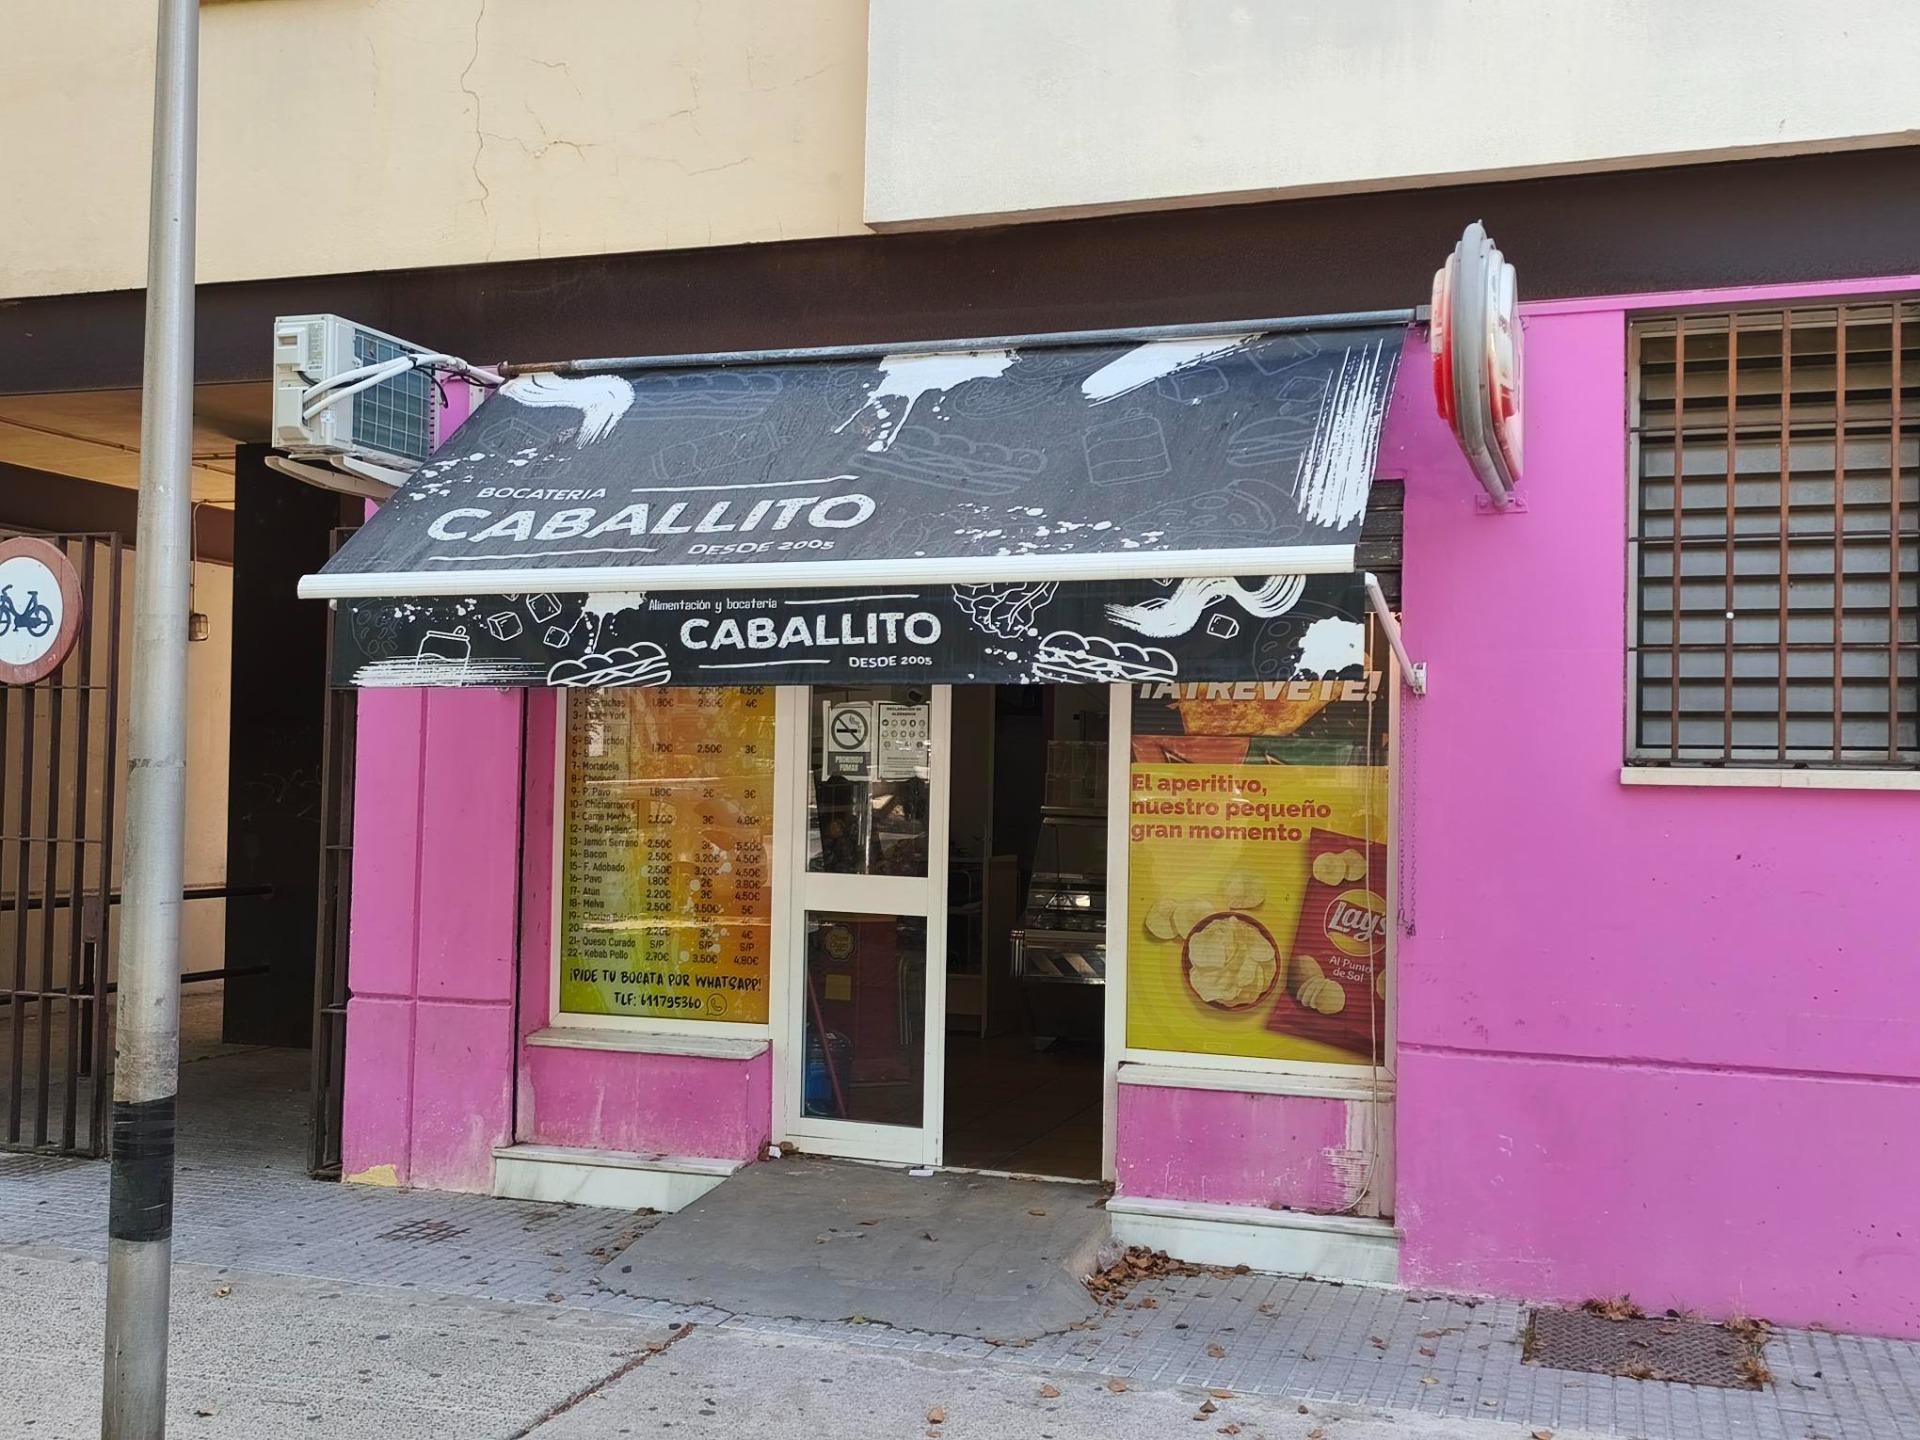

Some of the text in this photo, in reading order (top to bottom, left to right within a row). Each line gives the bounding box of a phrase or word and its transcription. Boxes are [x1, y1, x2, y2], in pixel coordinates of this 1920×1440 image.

[476, 486, 606, 501] BOCATERIA
[426, 493, 877, 542] CABALLITO
[687, 539, 835, 556] DESDE 2005
[648, 598, 711, 612] Alimentación
[714, 601, 722, 613] y
[680, 612, 941, 650] CABALLITO
[848, 655, 932, 668] DESDE 2005
[573, 698, 583, 707] 2-
[745, 699, 757, 708] 4€
[573, 711, 582, 720] 3-
[610, 711, 627, 720] York
[572, 736, 582, 744] 5-
[571, 749, 582, 757] 6-
[652, 743, 757, 754] 1.70€ 2.50€ 3€
[571, 761, 619, 771] 7- Mortadela
[571, 774, 581, 783] 8-
[1131, 773, 1267, 796] El aperitivo,
[571, 787, 580, 795] 9-
[703, 789, 714, 797] 2€
[744, 790, 756, 799] 3€
[1131, 799, 1332, 821] nuestro pequeño
[702, 816, 714, 825] 3€
[570, 824, 582, 833] 12-
[585, 824, 603, 833] Pollo
[1131, 823, 1303, 842] gran momento
[569, 837, 582, 846] 13-
[647, 839, 672, 848] 2.50€
[648, 852, 672, 861] 2.50€
[736, 855, 760, 864] 4.50€
[569, 862, 582, 870] 15-
[593, 862, 625, 872] Adobado
[648, 865, 672, 874] 2.50€
[694, 867, 720, 876] 3.20€
[735, 868, 760, 877] 4.50€
[584, 874, 602, 883] Pavo
[648, 877, 669, 886] 1.80€
[701, 879, 713, 888] 2€
[735, 880, 761, 889] 3.80€
[570, 886, 580, 895] 17-
[646, 890, 671, 899] 2.20€
[701, 890, 712, 899] 3€
[735, 892, 760, 901] 4.50€
[583, 899, 605, 908] Melva
[646, 903, 671, 912] 2.50€
[742, 905, 753, 914] 5€
[569, 911, 580, 920] 19-
[568, 923, 583, 932] 20-
[742, 931, 753, 940] 4€
[568, 936, 754, 952] 21- Queso Curado S/P S/P S/P
[568, 948, 759, 966] 22- Kebab Pollo 2.70€ 3.50€ 4.80€
[1329, 955, 1372, 974] Al Punto
[602, 969, 616, 983] TU
[620, 971, 664, 986] BOCATA
[668, 973, 690, 987] POR
[696, 974, 762, 992] WHATSAPP!
[1332, 967, 1365, 983] de Sal
[613, 992, 637, 1007] TLF:
